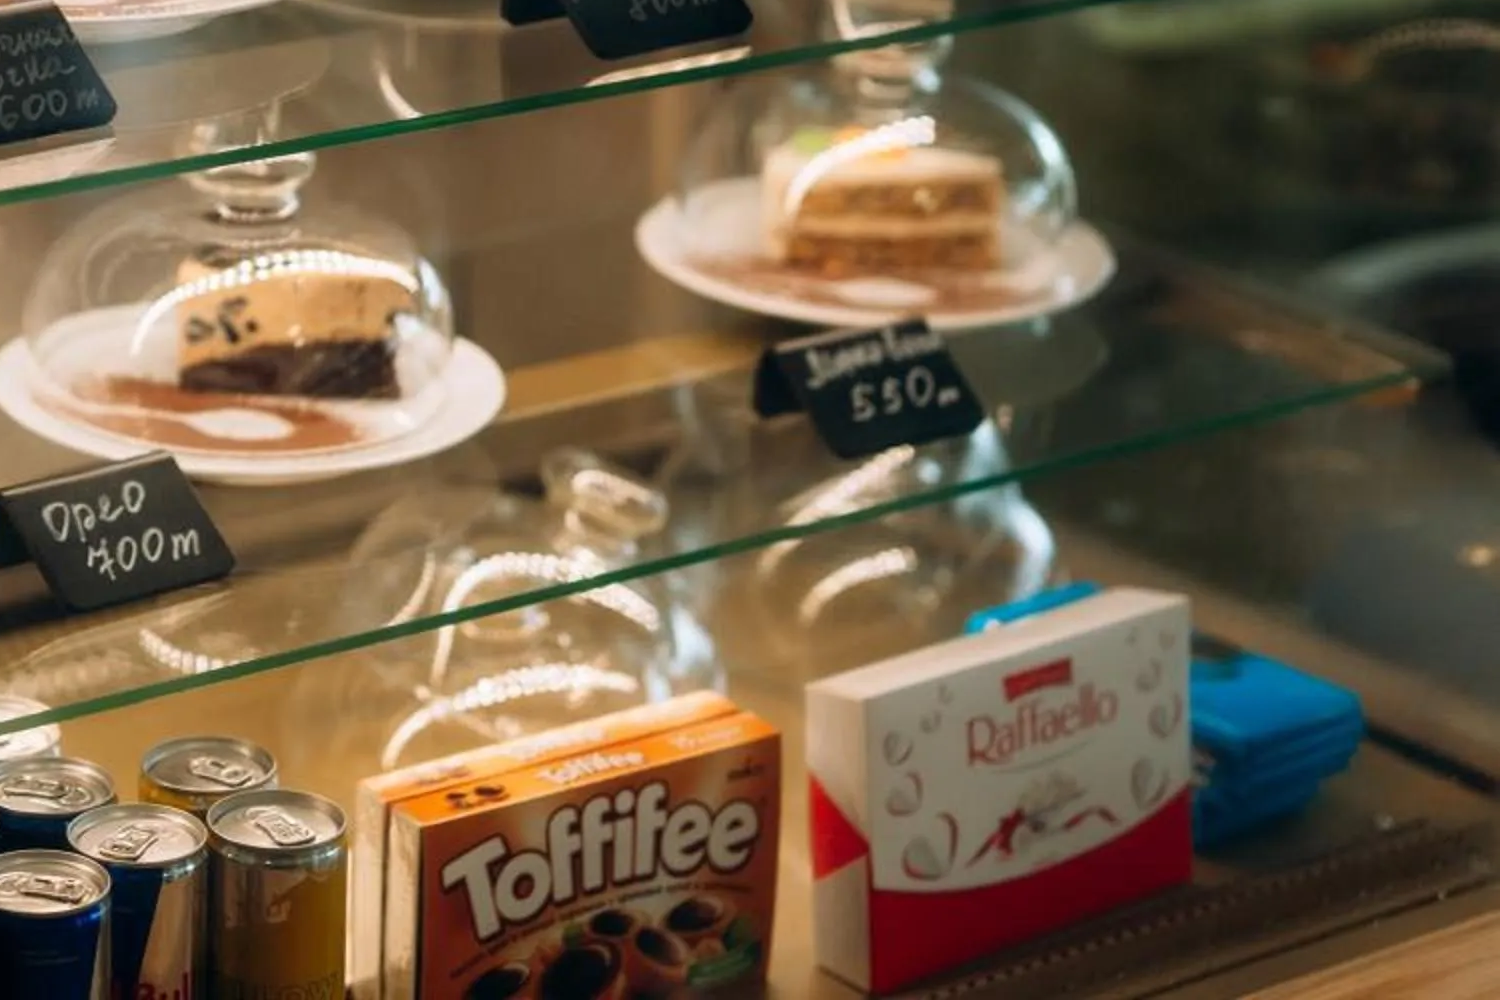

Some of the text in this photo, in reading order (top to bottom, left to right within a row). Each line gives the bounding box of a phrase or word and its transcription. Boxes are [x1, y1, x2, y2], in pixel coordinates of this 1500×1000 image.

[41, 480, 146, 543] Орео
[964, 680, 1120, 768] Raffaello
[441, 780, 761, 942] Toffifee
